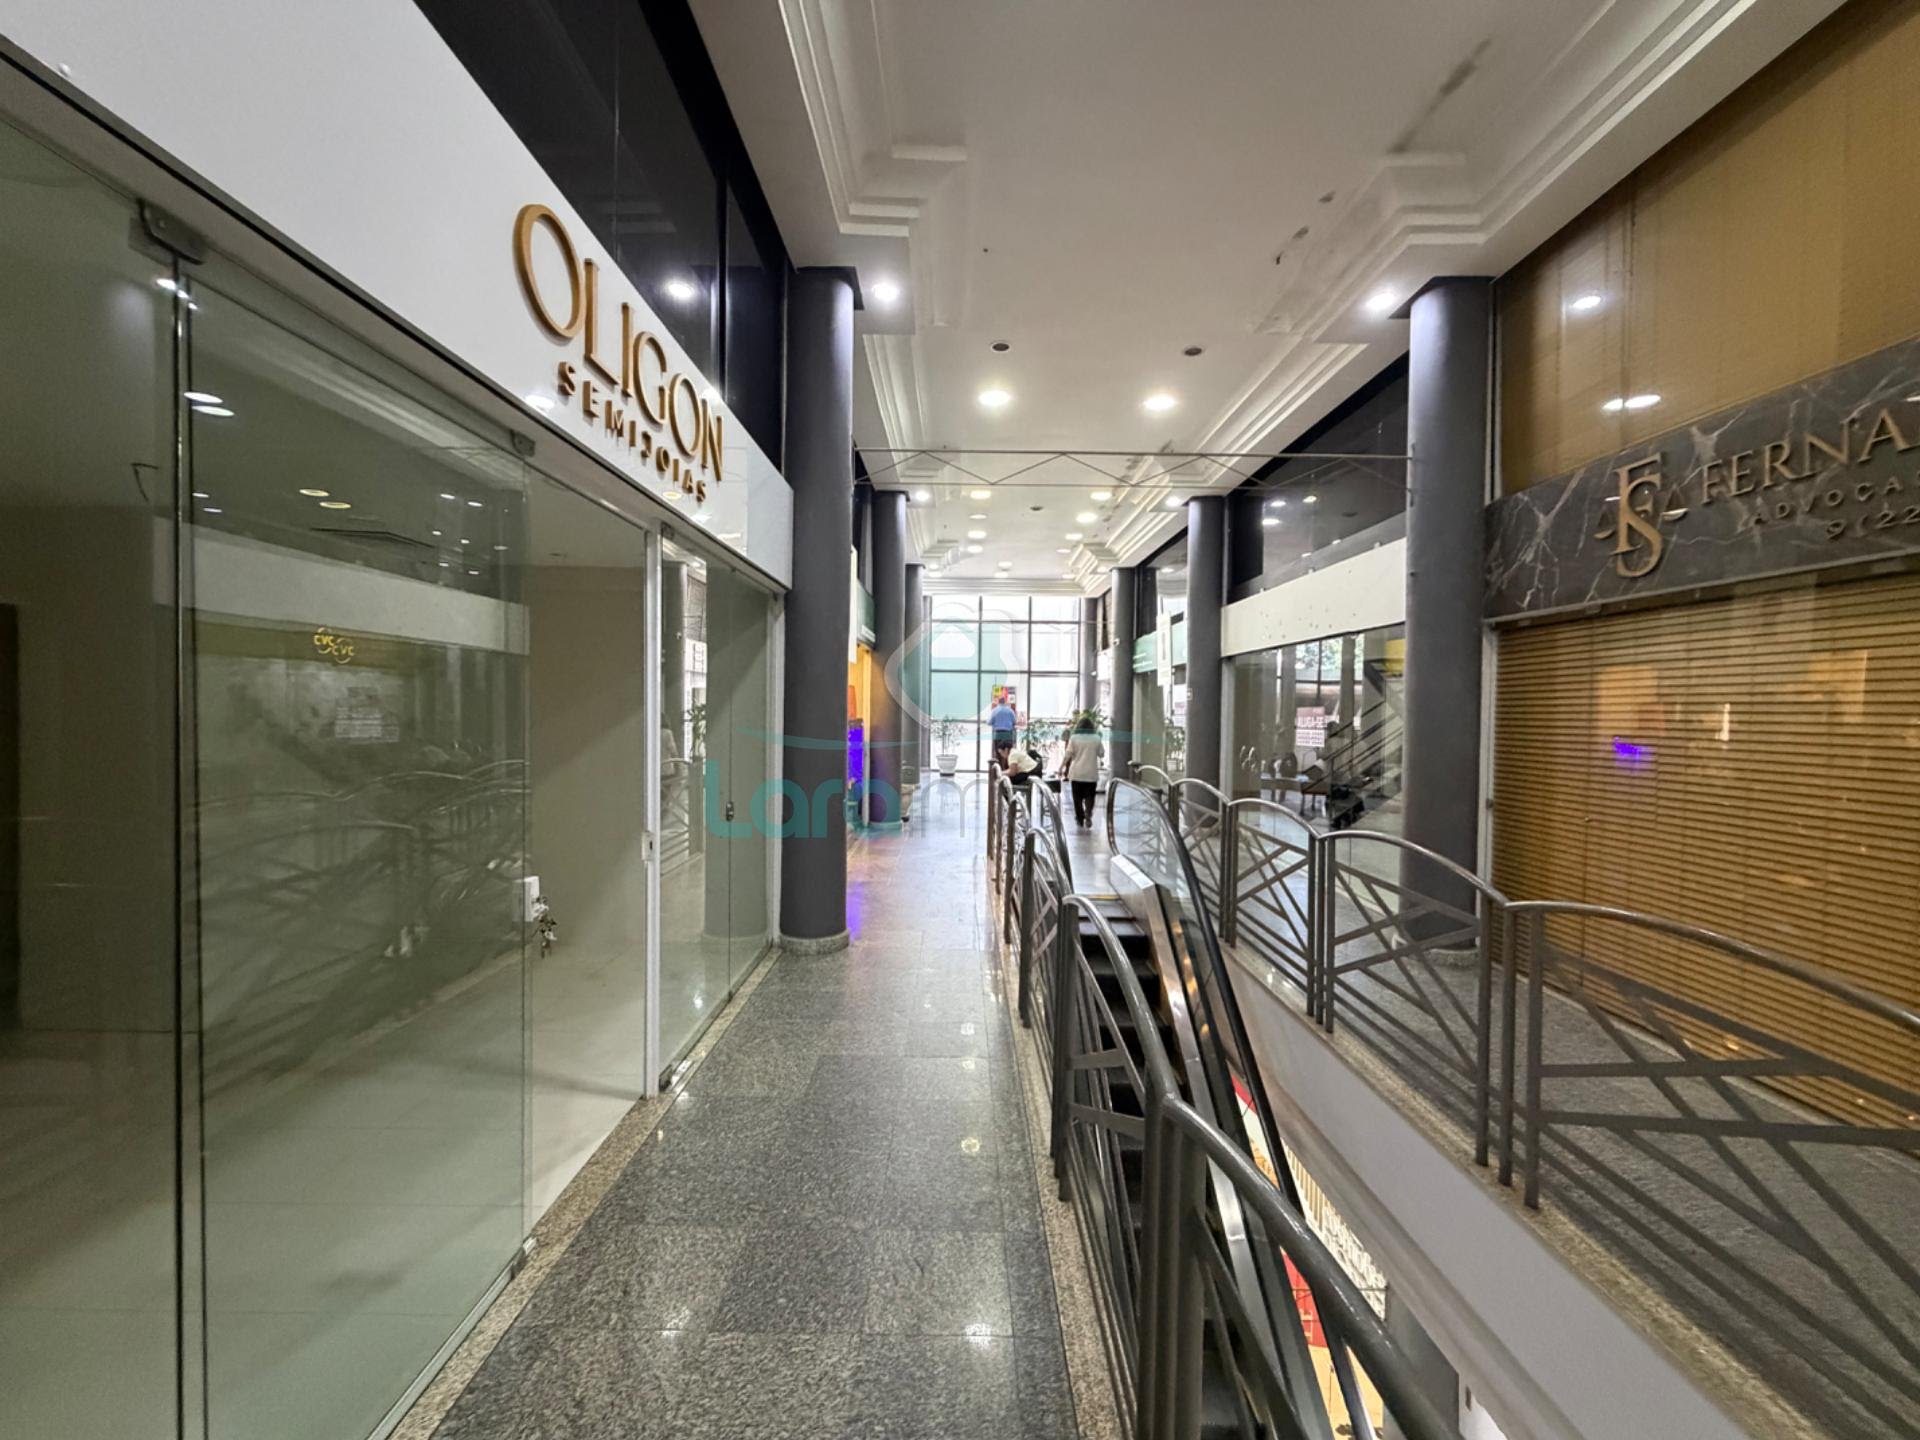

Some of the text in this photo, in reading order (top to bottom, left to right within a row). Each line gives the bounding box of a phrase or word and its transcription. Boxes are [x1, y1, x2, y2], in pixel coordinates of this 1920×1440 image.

[512, 204, 723, 482] OLIGON
[558, 361, 706, 503] SEMIJOIAS
[1699, 407, 1920, 505] FERNA
[1750, 471, 1920, 529] ADVOCA
